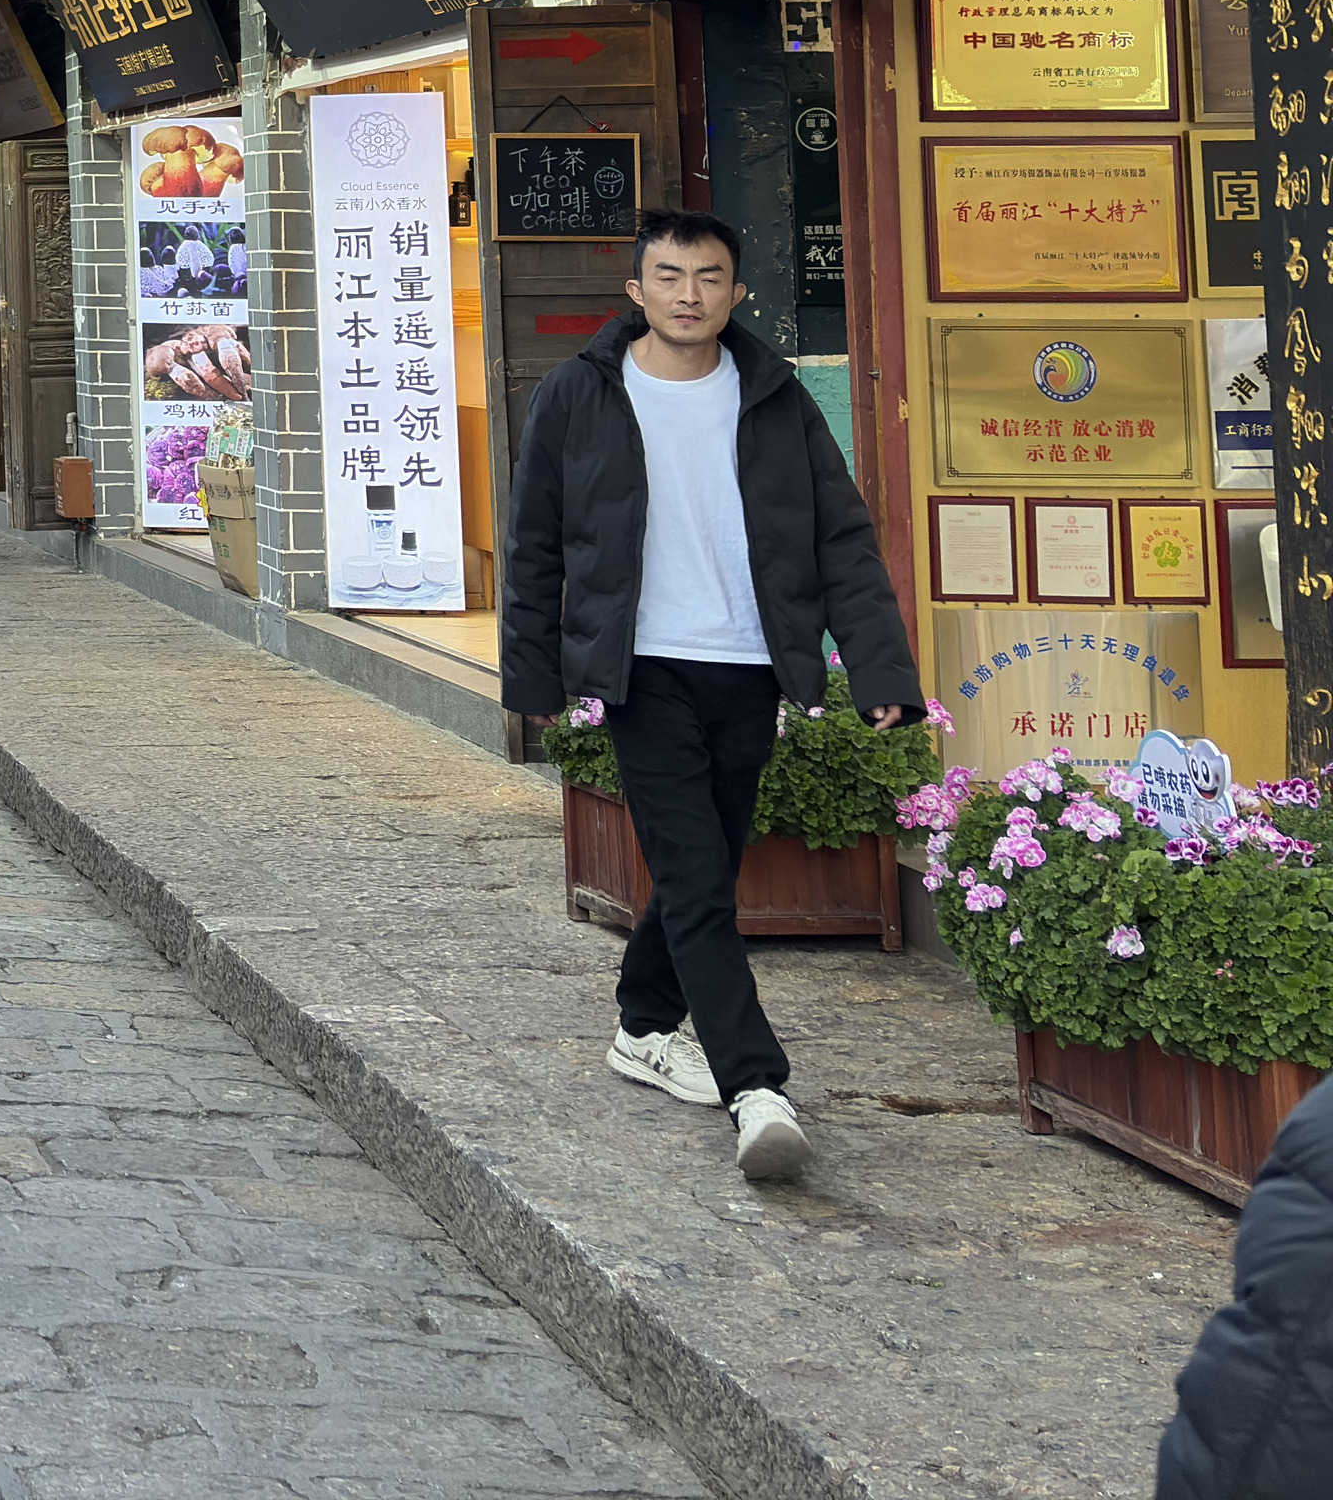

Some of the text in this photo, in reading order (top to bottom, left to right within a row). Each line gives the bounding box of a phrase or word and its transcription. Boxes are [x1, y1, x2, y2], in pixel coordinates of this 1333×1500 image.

[963, 31, 1135, 50] 中国驰名商标
[1225, 88, 1253, 97] Depart
[509, 145, 587, 177] 下午茶
[341, 182, 420, 191] Cloud Essence
[157, 200, 231, 216] 见手青
[335, 197, 427, 211] 云南小众香水
[509, 186, 591, 213] 咖啡
[952, 199, 1160, 224] 首届丽江“十大特产”
[803, 226, 842, 235] 这就是你
[805, 245, 844, 266] 我们
[160, 301, 233, 317] 竹荪菌
[334, 226, 387, 482] 丽江本土品牌
[389, 220, 443, 487] 销量遥遥领先
[980, 419, 1156, 438] 诚信经营 放心消费
[1224, 423, 1273, 438] 工商行政
[1026, 445, 1113, 463] 示范企业
[178, 506, 203, 521] 红
[959, 633, 1190, 702] 旅游购物三十天无理由退货
[1011, 710, 1148, 739] 承诺门店
[1141, 762, 1192, 797] 已喷农药
